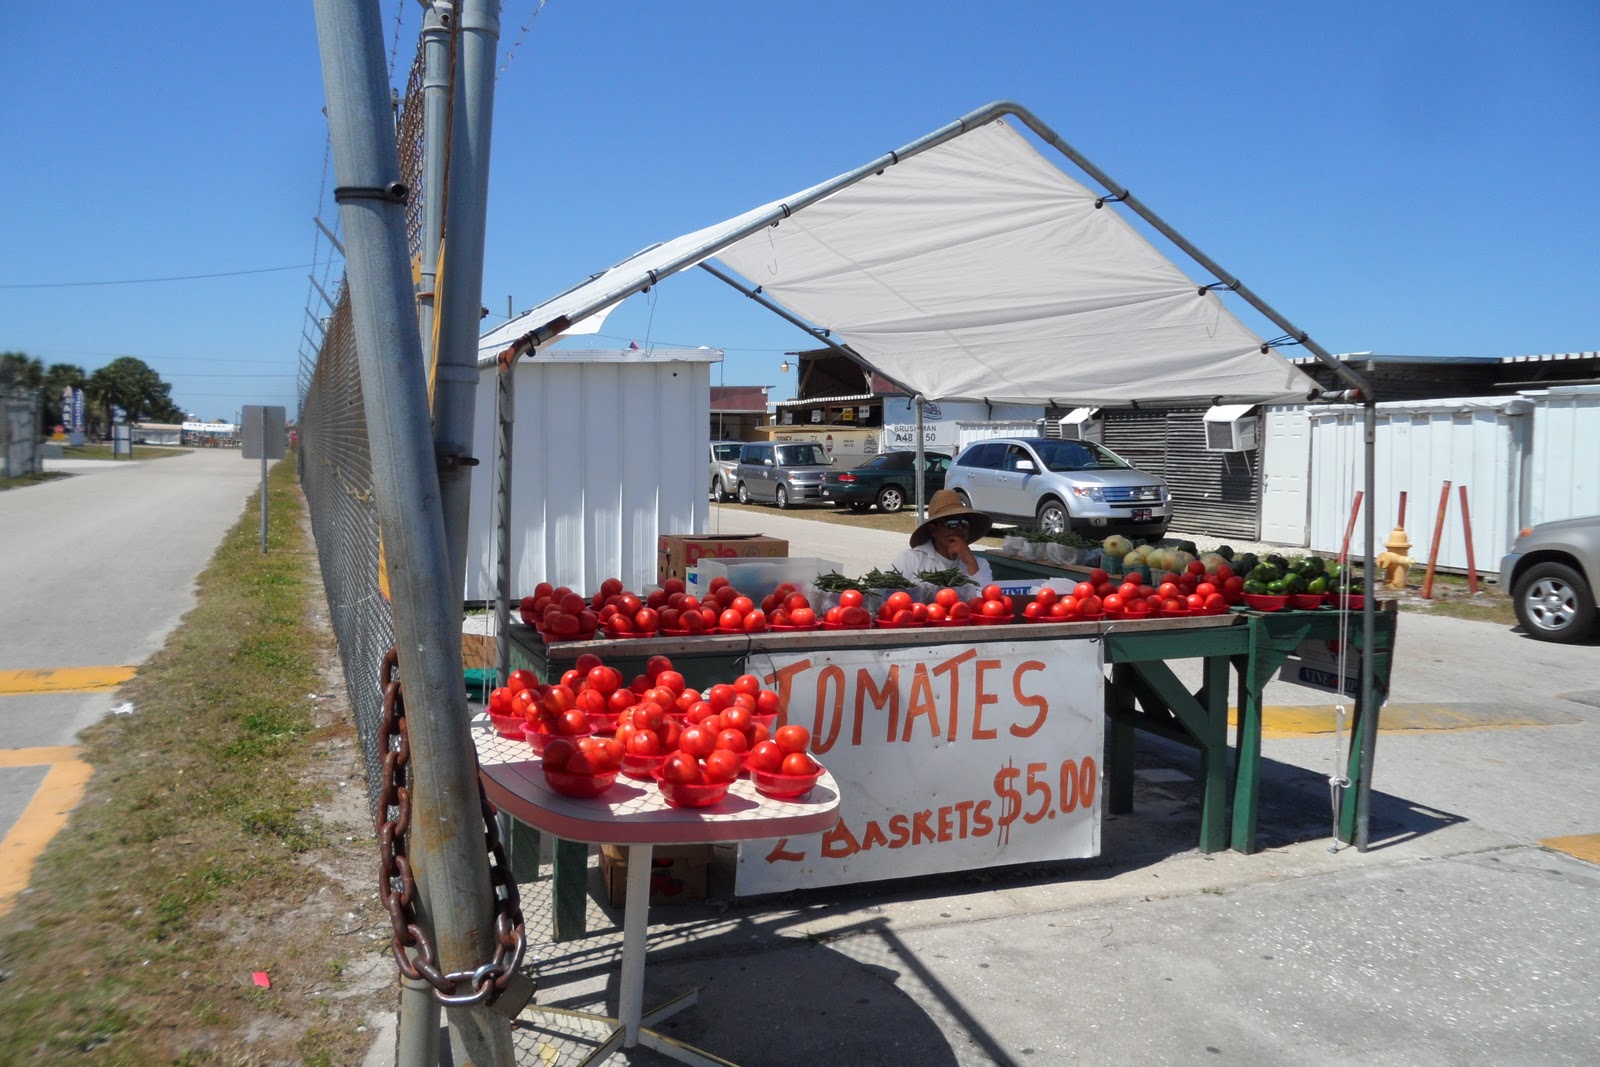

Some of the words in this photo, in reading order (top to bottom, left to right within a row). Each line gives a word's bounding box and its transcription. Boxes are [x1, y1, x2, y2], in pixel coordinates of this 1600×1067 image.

[764, 648, 1049, 755] TOMATES
[820, 800, 994, 859] BASKETS
[993, 755, 1096, 846] $5.00
